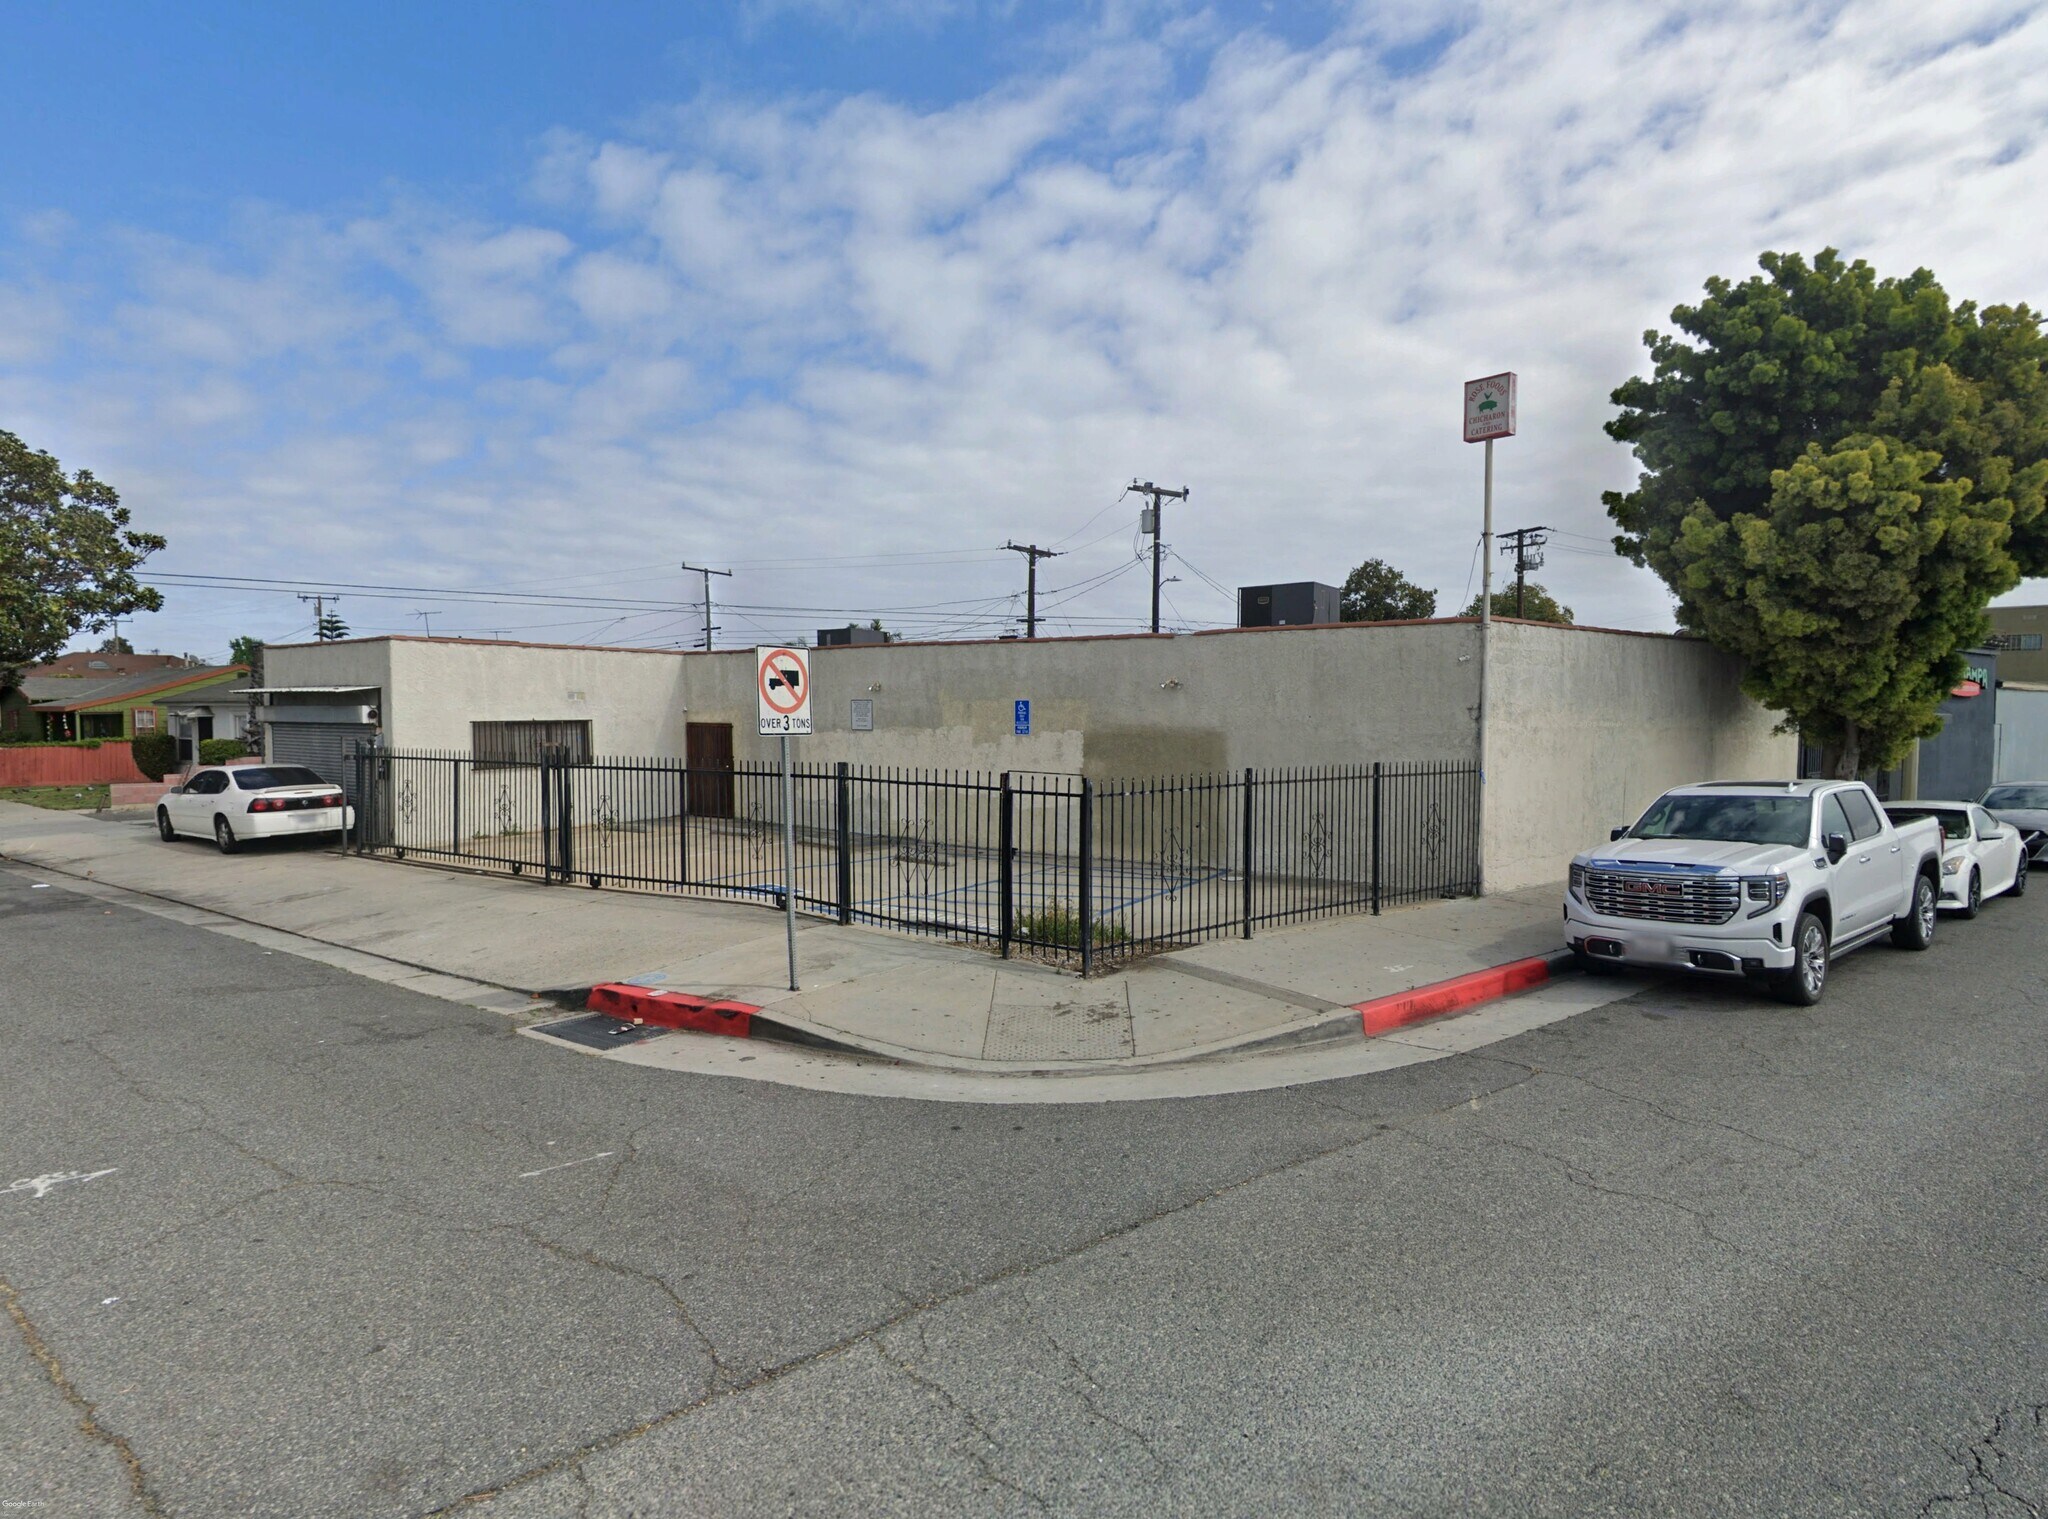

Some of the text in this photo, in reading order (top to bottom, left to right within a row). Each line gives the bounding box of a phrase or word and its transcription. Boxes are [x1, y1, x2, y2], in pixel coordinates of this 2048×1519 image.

[1468, 380, 1507, 403] ROSE FOODS
[1468, 410, 1506, 425] CHICHARON
[1471, 423, 1503, 436] CATERING
[760, 714, 811, 731] OVER 3 TONS
[1624, 881, 1681, 895] GMC
